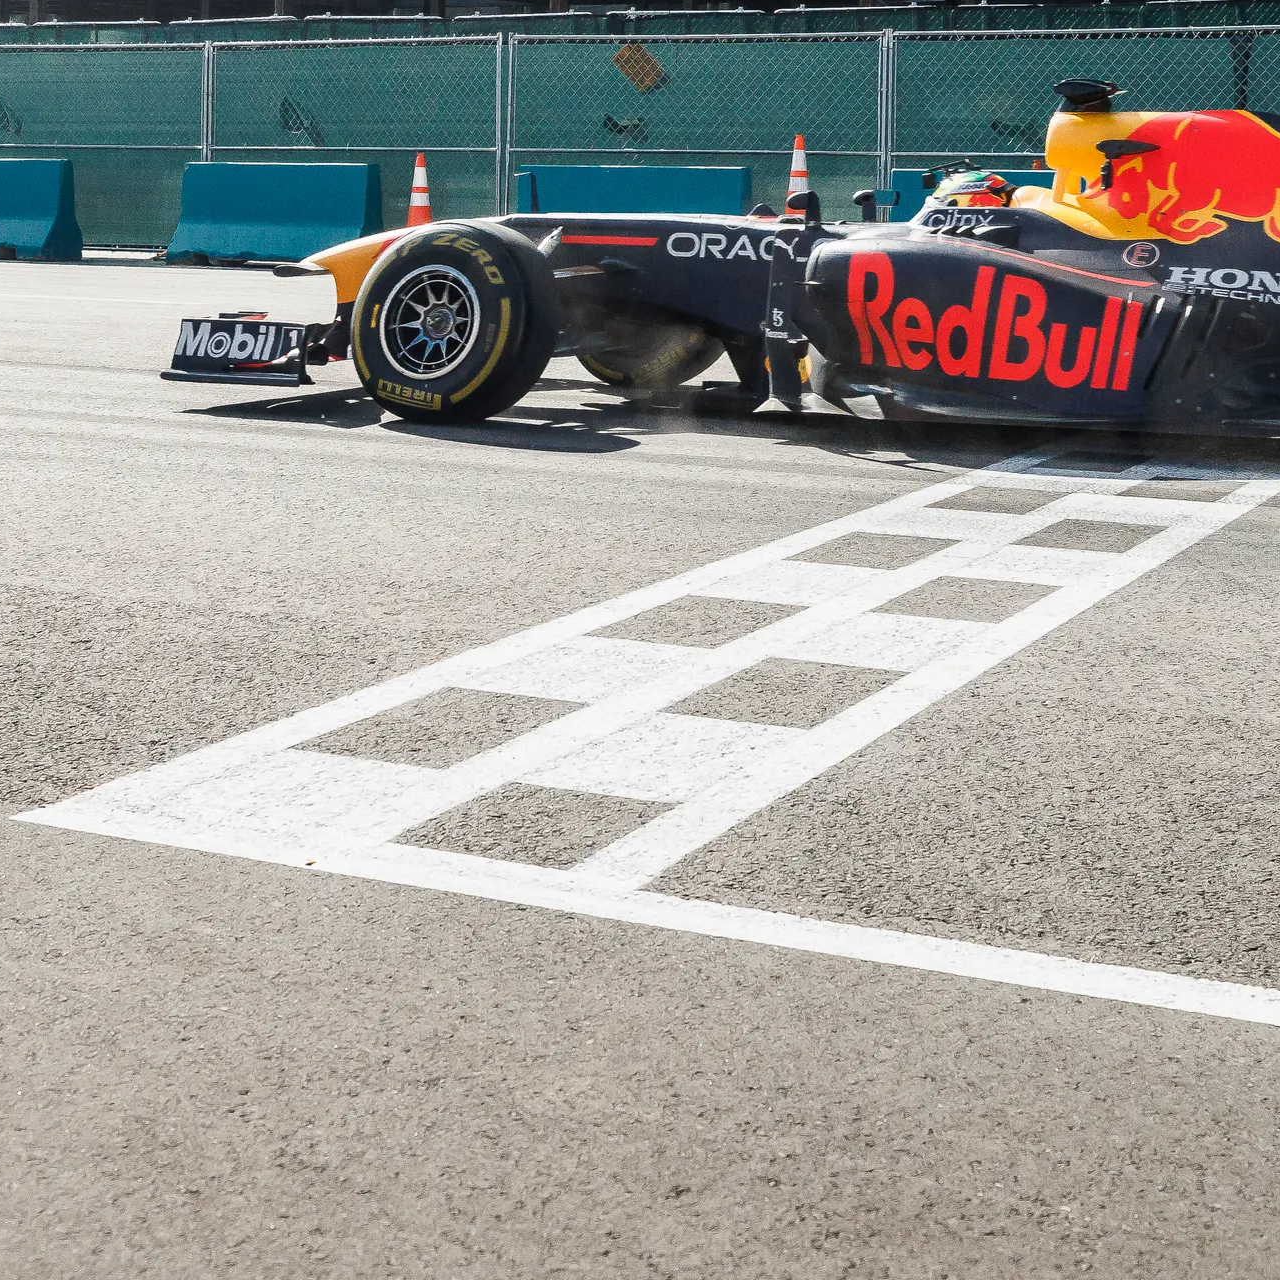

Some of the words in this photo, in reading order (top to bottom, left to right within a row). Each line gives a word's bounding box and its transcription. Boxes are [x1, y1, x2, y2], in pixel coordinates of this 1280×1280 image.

[928, 209, 994, 228] citrix
[432, 232, 506, 285] ZERO
[175, 321, 277, 361] Mobil
[377, 378, 442, 411] PIRELLI
